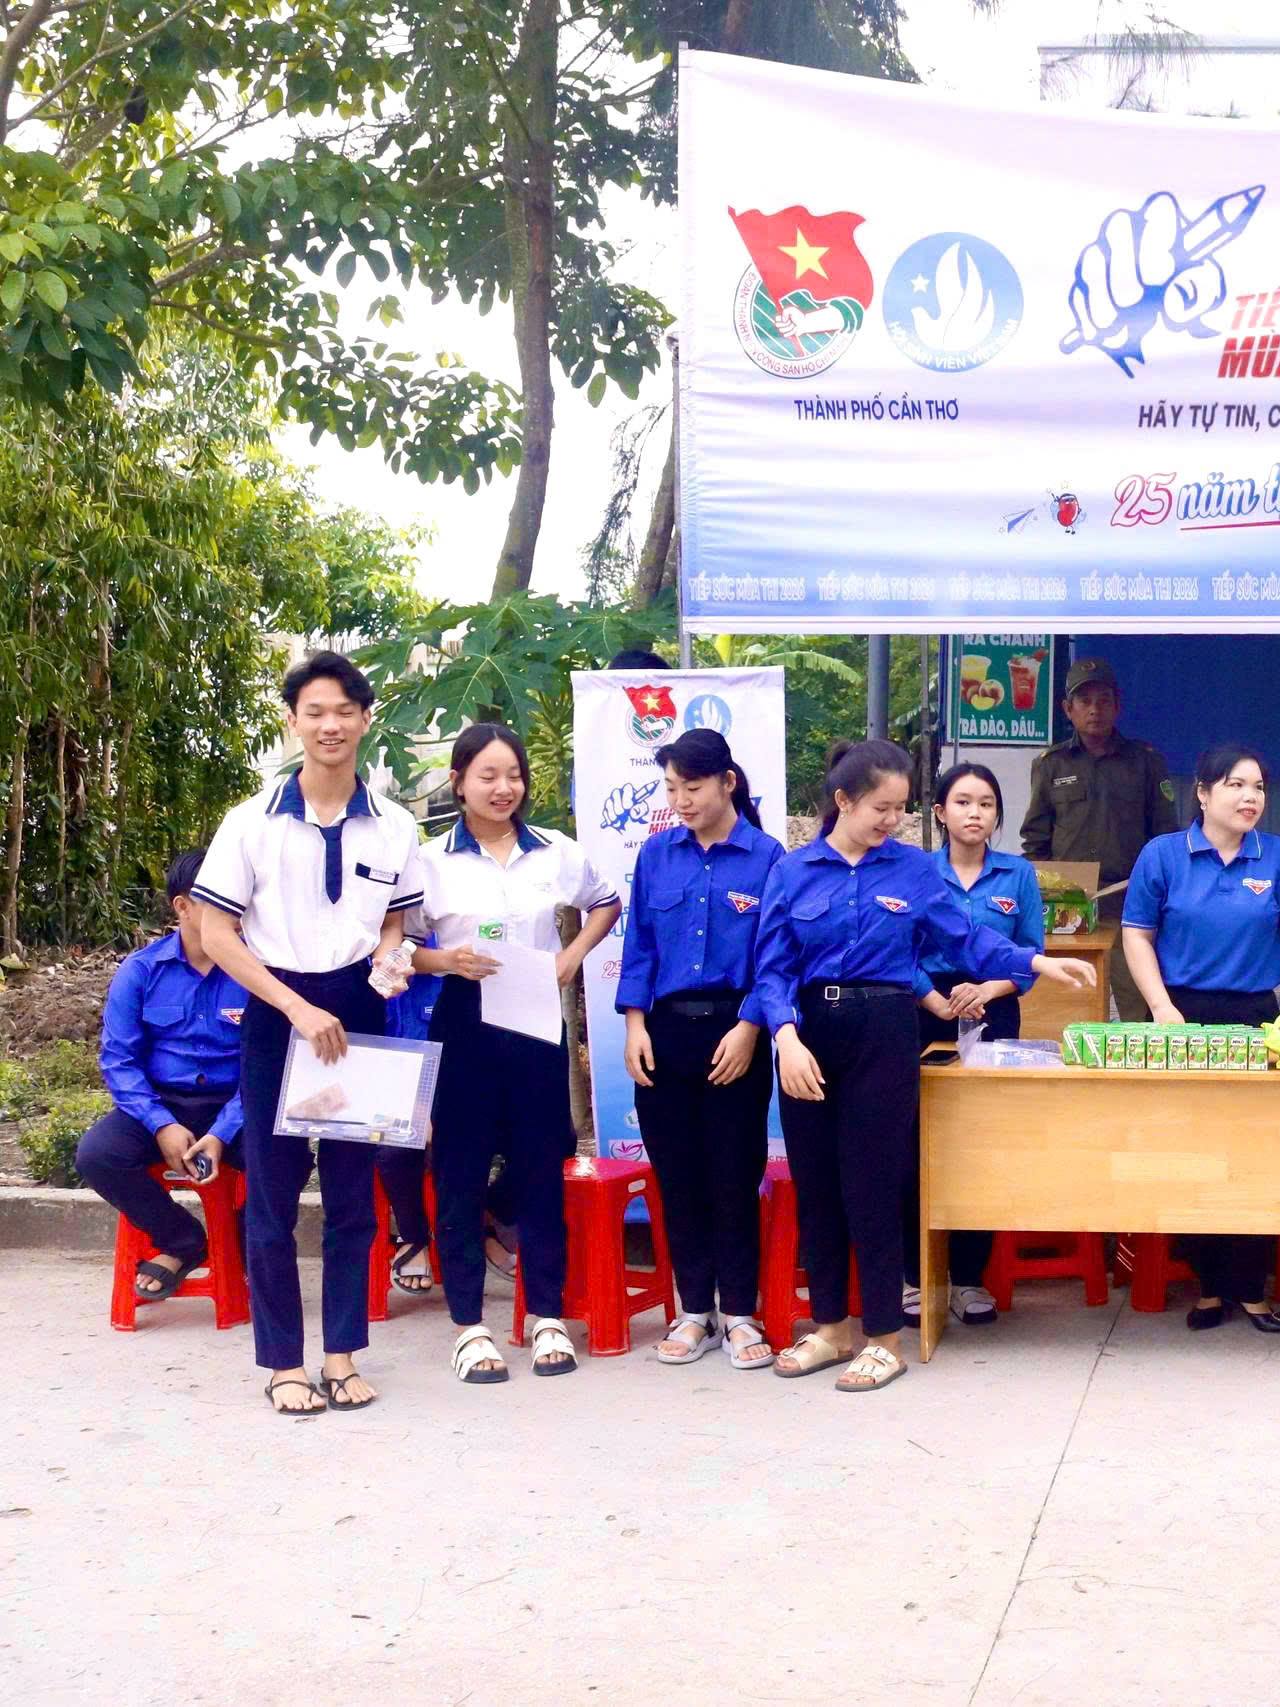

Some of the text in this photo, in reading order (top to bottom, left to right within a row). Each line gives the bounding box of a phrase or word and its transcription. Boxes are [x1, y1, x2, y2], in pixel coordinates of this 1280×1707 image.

[794, 390, 960, 421] THÀNH PHỐ CẦN THƠ
[1138, 399, 1182, 428] HÃY
[1188, 401, 1219, 433] TỰ
[1223, 402, 1260, 432] TIN,
[1110, 471, 1177, 528] 25
[1176, 471, 1260, 521] năm
[688, 570, 806, 601] TIẾP SỨC MÙA THI 2026
[1080, 569, 1198, 601] TIẾP SỨC MÙA THI 2026
[1211, 570, 1236, 601] TIẾP
[1236, 572, 1259, 601] SỨC
